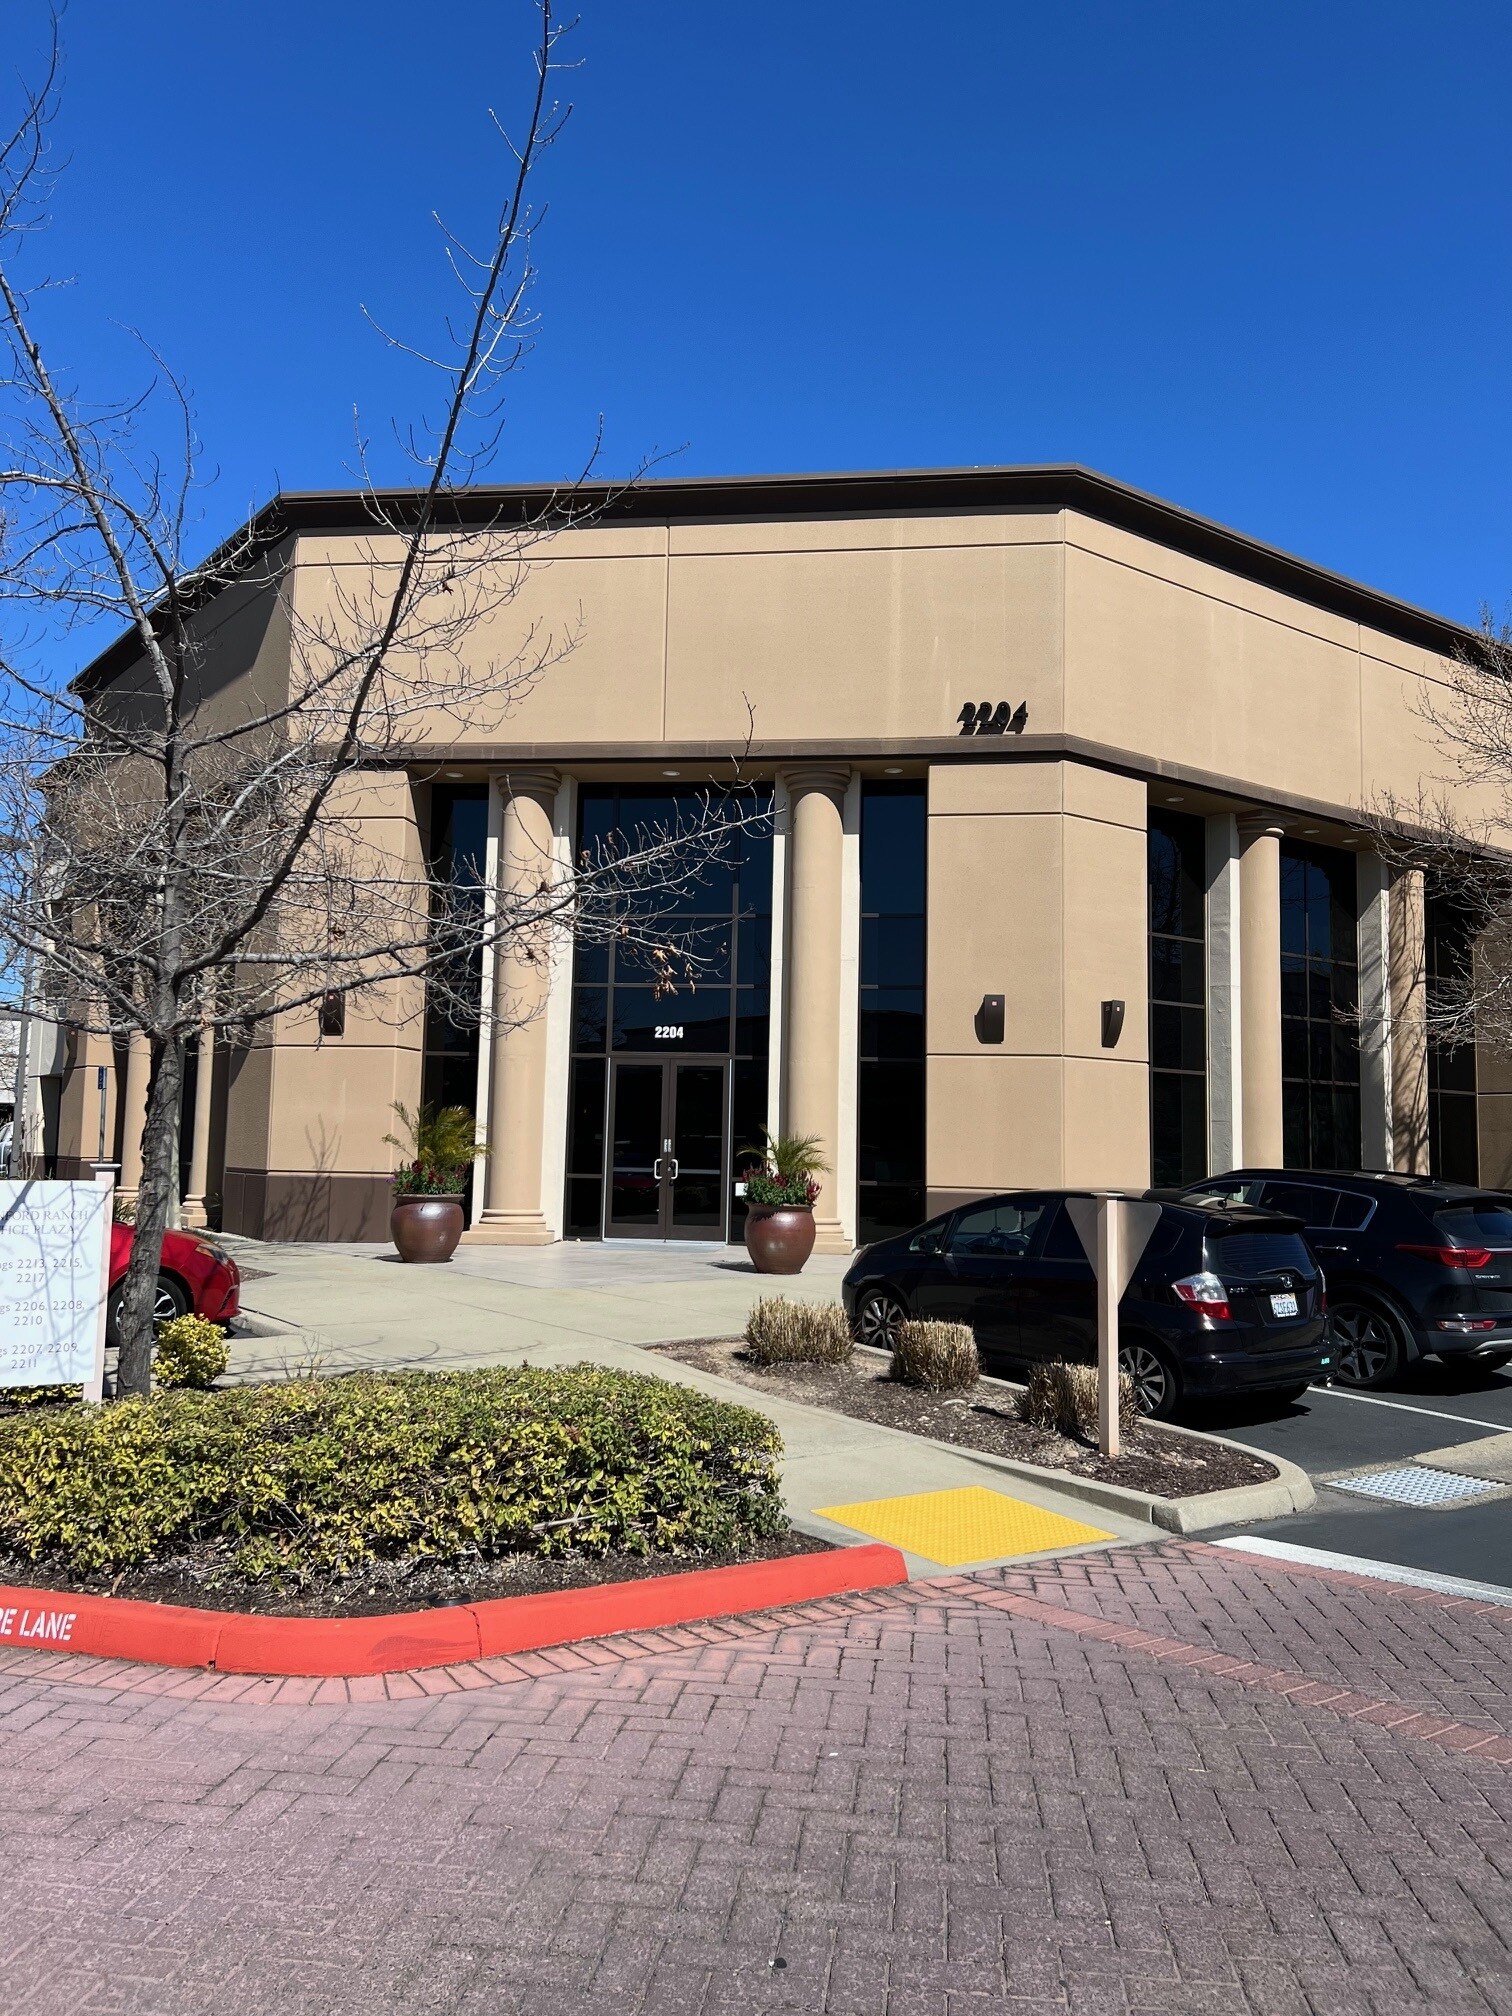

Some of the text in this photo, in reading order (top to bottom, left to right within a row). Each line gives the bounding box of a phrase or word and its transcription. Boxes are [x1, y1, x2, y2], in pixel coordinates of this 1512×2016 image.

[958, 700, 1029, 735] 2204
[654, 1026, 684, 1038] 2204
[44, 1210, 88, 1221] RANCH
[34, 1224, 75, 1235] PLAZA
[0, 1257, 83, 1272] gs 2213, 2215,
[16, 1272, 45, 1284] 2217
[52, 1300, 85, 1311] 2208,
[13, 1315, 43, 1326] 2210
[48, 1342, 79, 1353] 2209,
[11, 1358, 37, 1369] 2211
[19, 1608, 78, 1641] LANE
